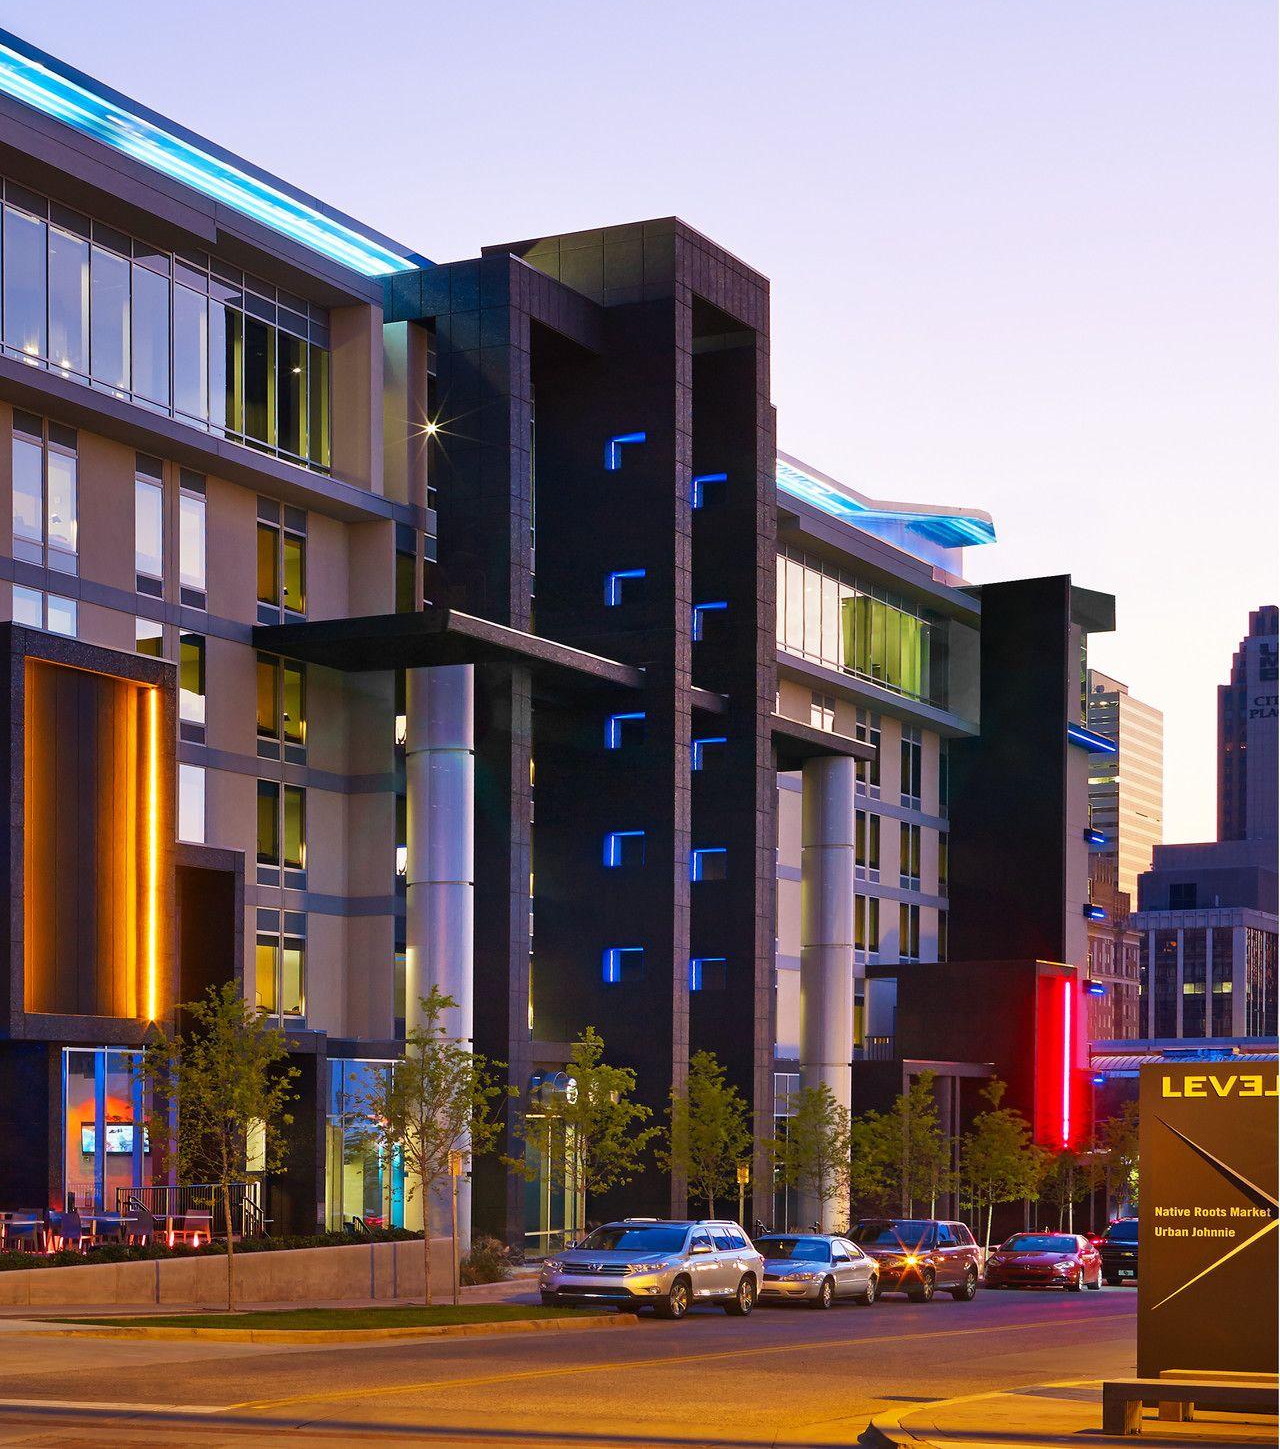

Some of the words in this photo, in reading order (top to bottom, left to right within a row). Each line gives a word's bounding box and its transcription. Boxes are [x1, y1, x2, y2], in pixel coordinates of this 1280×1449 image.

[1154, 1206, 1191, 1217] Native
[1194, 1206, 1227, 1217] Roots
[1230, 1207, 1272, 1217] Market
[1154, 1227, 1189, 1237] Urban
[1191, 1227, 1236, 1237] Johnnie
